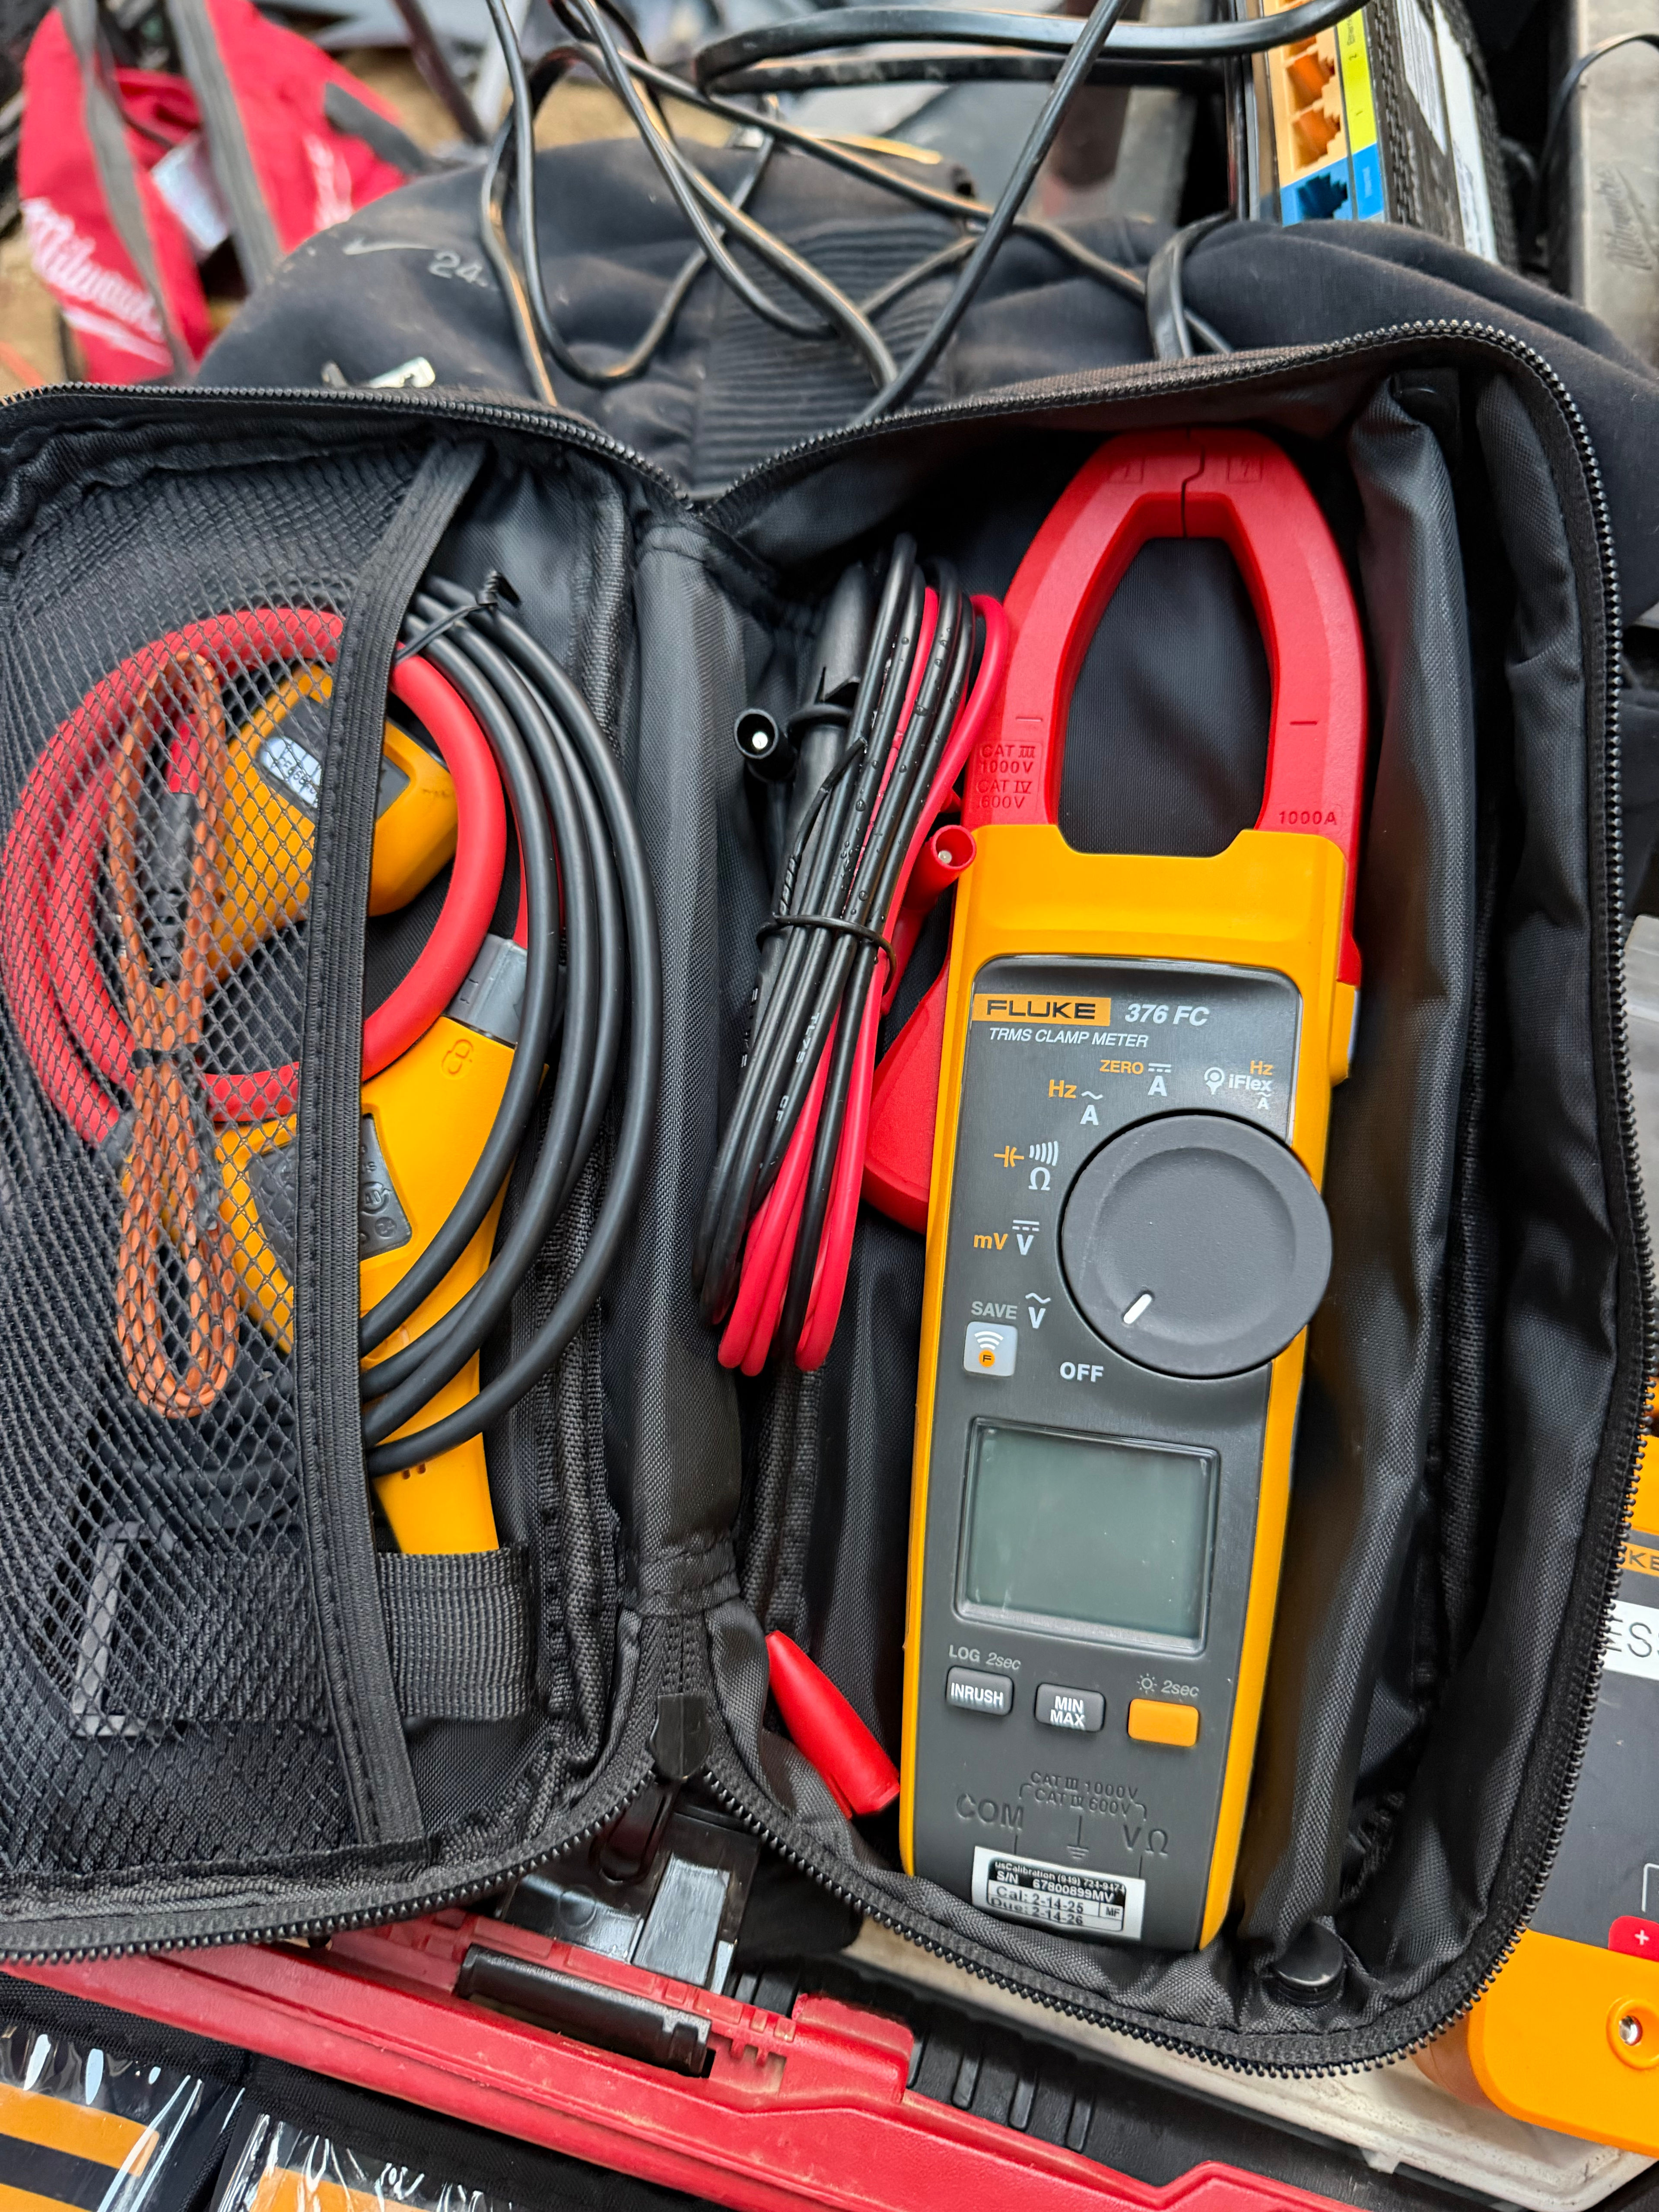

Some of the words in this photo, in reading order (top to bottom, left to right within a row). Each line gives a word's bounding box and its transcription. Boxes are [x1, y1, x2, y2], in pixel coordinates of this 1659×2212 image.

[981, 744, 1015, 758] CAT
[1018, 745, 1036, 758] III
[976, 779, 1010, 793] CAT
[1013, 780, 1033, 794] IV
[981, 795, 1025, 809] 600V
[1279, 811, 1338, 826] 1000A
[987, 1000, 1096, 1020] FLUKE
[1125, 1004, 1168, 1024] 376
[1173, 1006, 1210, 1026] FC
[989, 1027, 1032, 1042] TRMS
[1035, 1028, 1090, 1044] CLAMP
[1091, 1032, 1148, 1048] METER
[1099, 1059, 1144, 1074] ZERO
[1249, 1060, 1274, 1076] Hz
[1048, 1079, 1077, 1099] Hz
[1147, 1075, 1167, 1097] A
[1228, 1073, 1273, 1092] iFlex
[1257, 1097, 1269, 1110] A
[1080, 1104, 1099, 1126] A
[973, 1232, 1008, 1250] mV
[1016, 1233, 1034, 1255] V
[971, 1300, 1018, 1319] SAVE
[1028, 1306, 1046, 1329] V
[982, 1354, 992, 1363] F
[1059, 1361, 1104, 1382] OFF
[948, 1644, 981, 1663] LOG
[985, 1652, 1021, 1671] 2sec
[950, 1682, 1004, 1707] INRUSH
[1160, 1679, 1200, 1697] 2sec
[1054, 1695, 1084, 1713] MIN
[1050, 1709, 1086, 1730] MAX
[1030, 1771, 1062, 1789] CAT
[1064, 1776, 1079, 1793] III
[1084, 1780, 1139, 1802] 1000V
[956, 1793, 1024, 1834] COM
[1034, 1788, 1065, 1805] CAT
[1070, 1794, 1084, 1810] IV
[1089, 1797, 1132, 1818] 600V
[995, 1861, 1055, 1880] usCalibration
[996, 1870, 1019, 1884] S/N
[1032, 1878, 1114, 1903] 67800899MV
[996, 1885, 1028, 1904] Cal:
[1032, 1893, 1084, 1914] 2-14-25
[991, 1897, 1029, 1913] Due:
[1032, 1907, 1084, 1925] 2-14-26
[1105, 1906, 1121, 1917] MF
